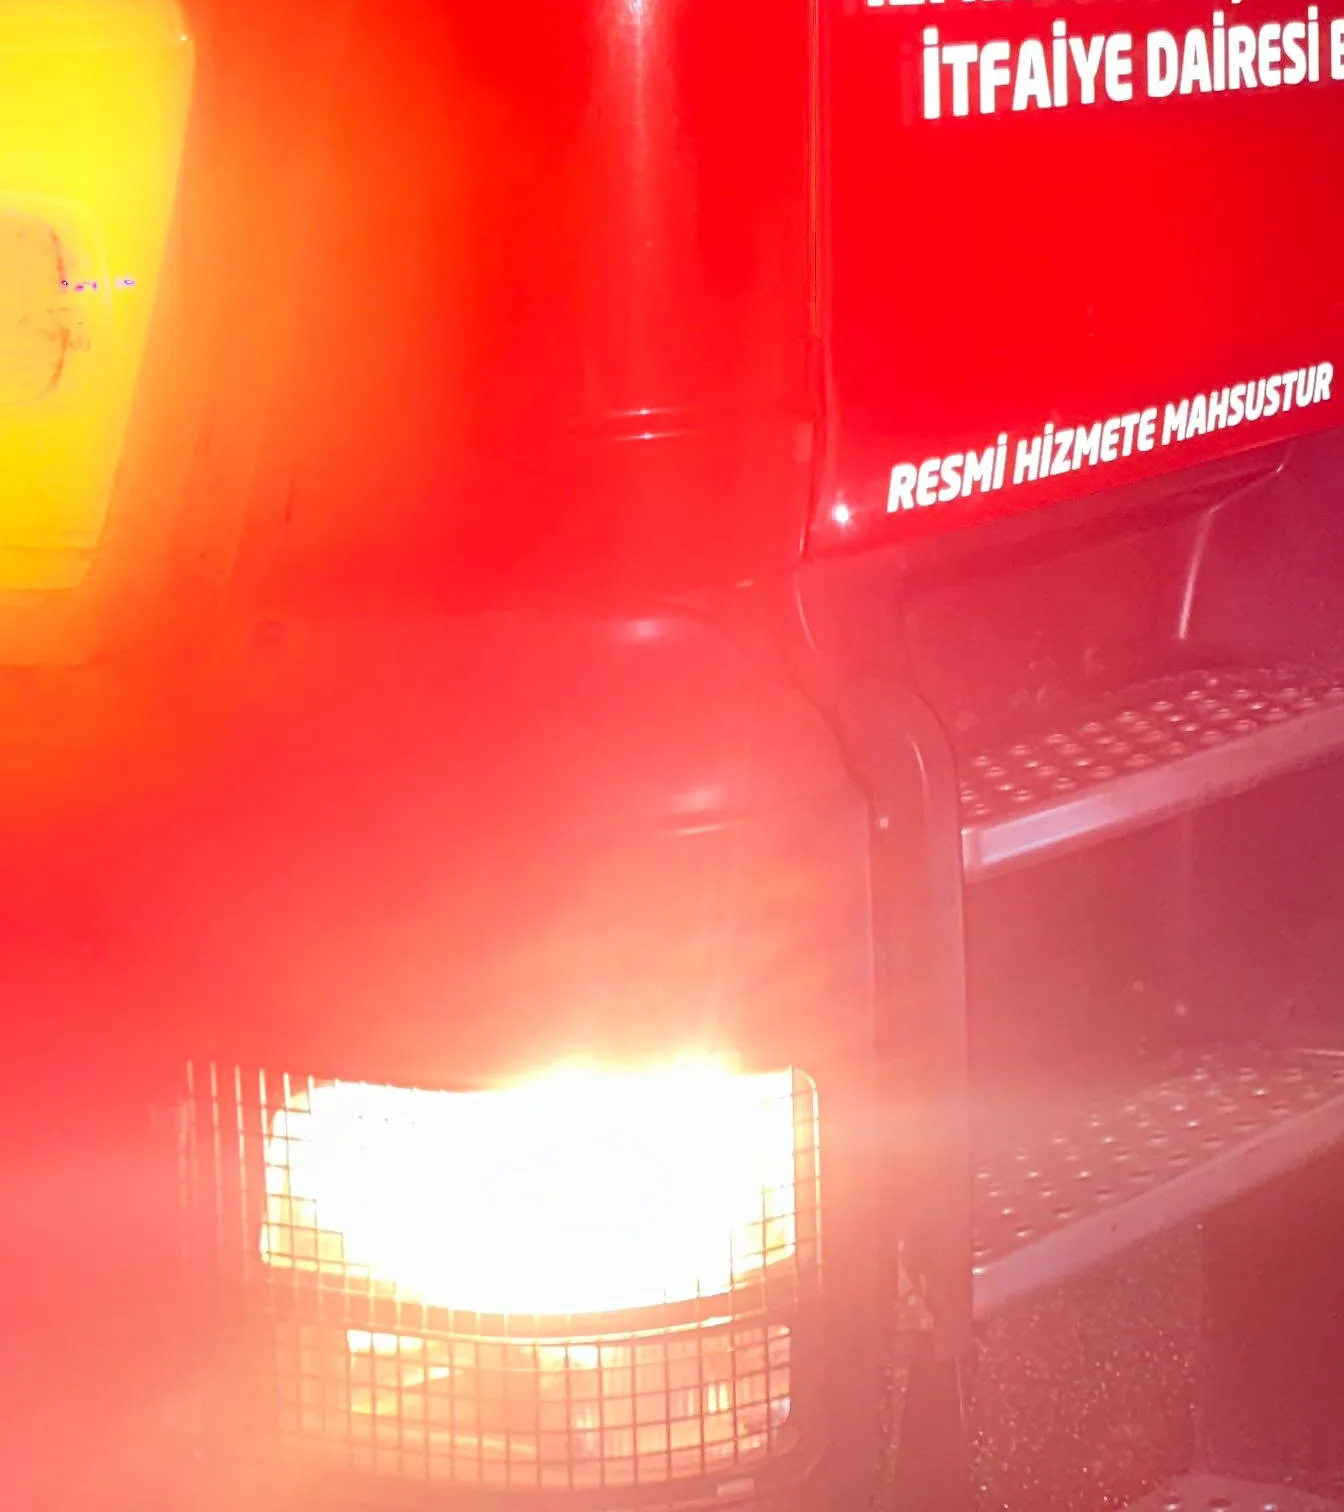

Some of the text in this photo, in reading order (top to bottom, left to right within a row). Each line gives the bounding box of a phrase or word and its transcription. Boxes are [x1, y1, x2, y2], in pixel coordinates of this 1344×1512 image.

[922, 18, 1133, 120] İTFAİYE
[1146, 4, 1320, 99] DAİRESİ
[886, 361, 1335, 513] RESMİ HİZMETE MAHSUSTUR
